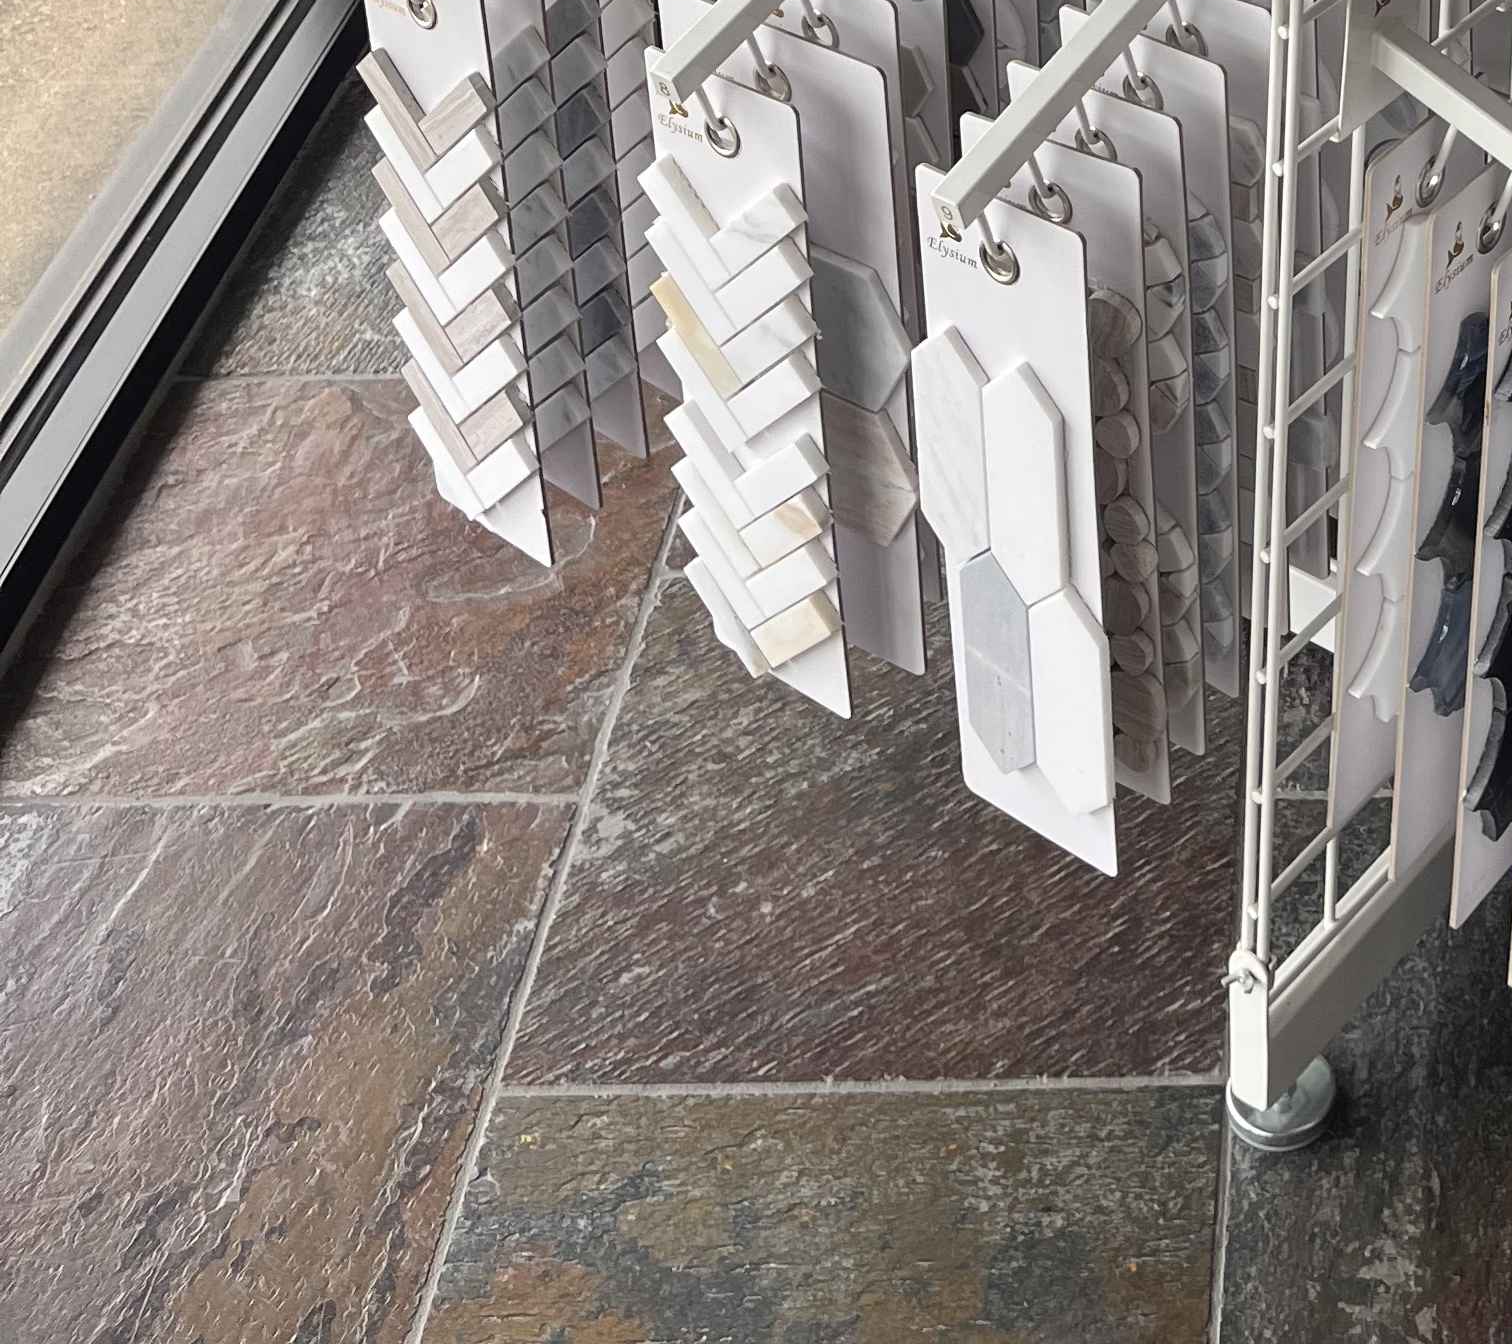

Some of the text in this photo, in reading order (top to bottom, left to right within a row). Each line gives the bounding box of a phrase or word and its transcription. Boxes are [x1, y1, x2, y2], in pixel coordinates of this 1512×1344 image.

[658, 113, 703, 143] Elysium
[941, 206, 953, 220] 9
[928, 236, 978, 269] Elysium
